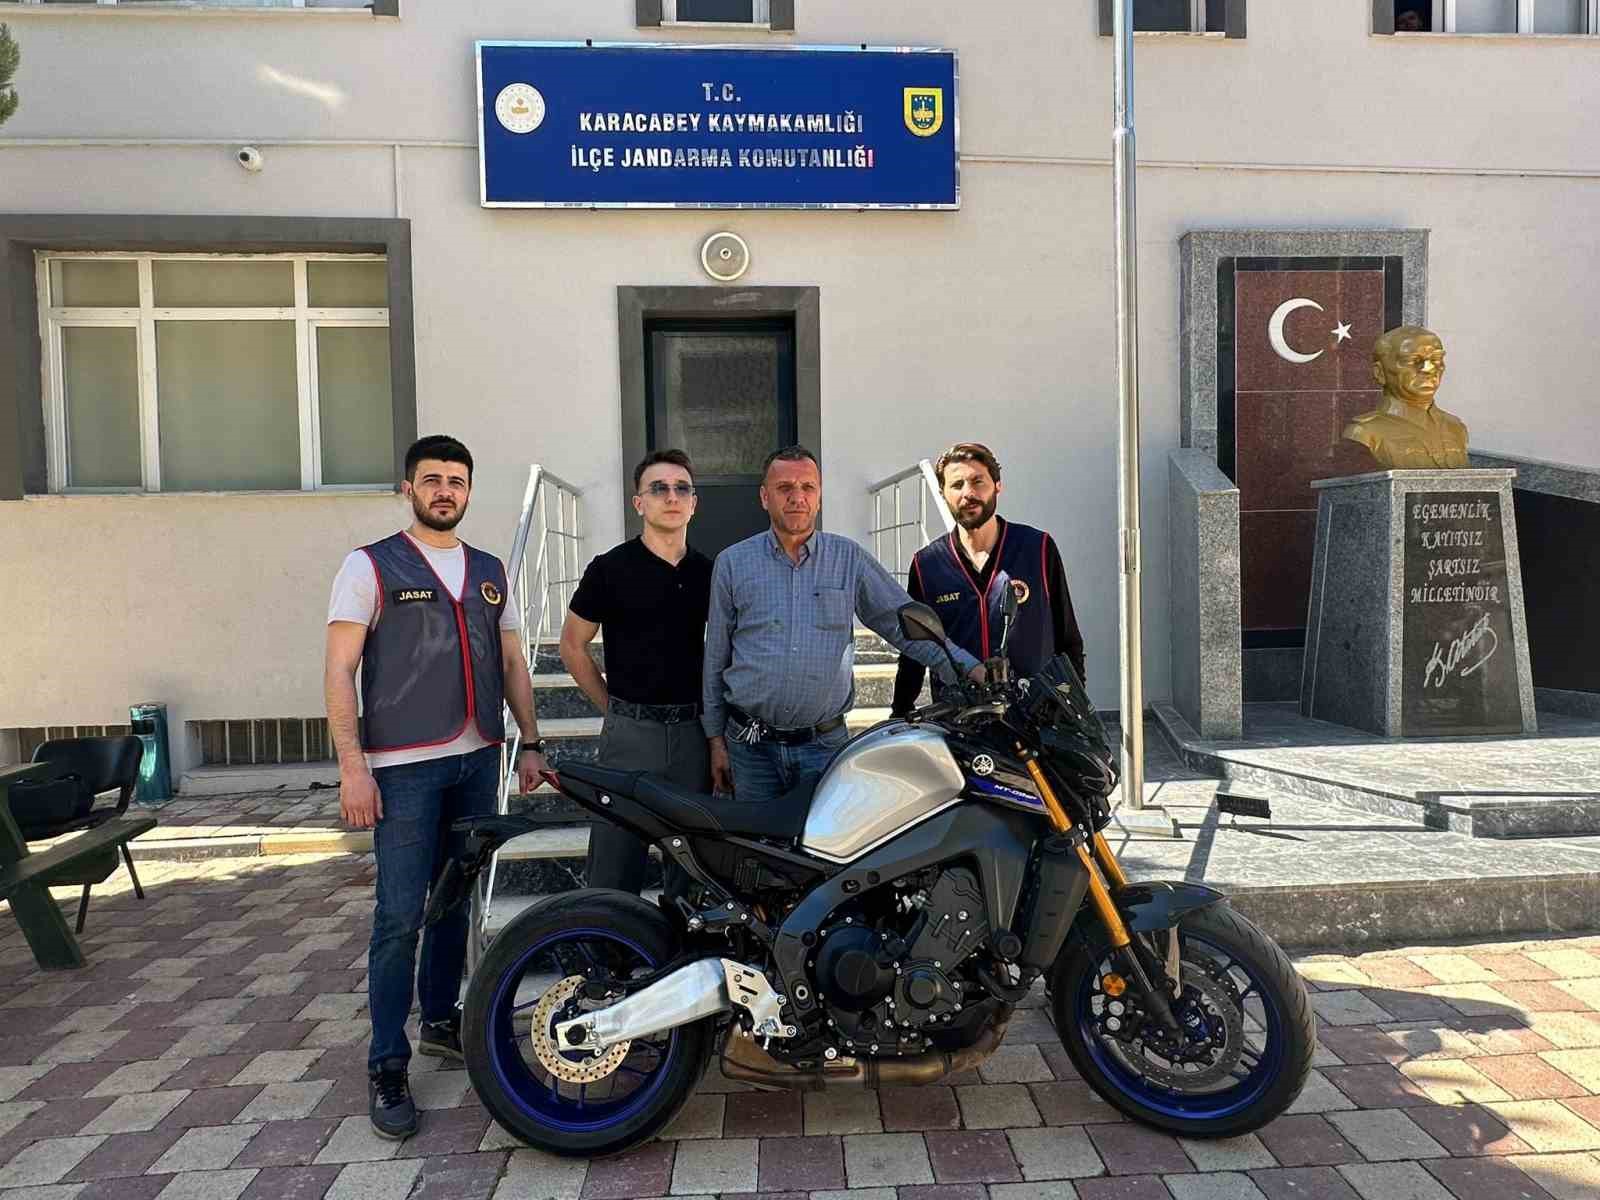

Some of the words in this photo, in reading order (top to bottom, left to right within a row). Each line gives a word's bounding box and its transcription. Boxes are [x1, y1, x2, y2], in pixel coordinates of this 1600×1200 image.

[702, 82, 742, 102] T.C.
[579, 112, 701, 132] KARACABEY
[708, 110, 863, 133] KAYMAKAMLIĞI
[571, 144, 614, 172] İLÇE
[621, 148, 733, 167] JANDARMA
[739, 144, 874, 168] KOMUTANLIĞI
[1412, 499, 1492, 524] EGEMENLİK
[1421, 530, 1484, 549] KAYITSIZ
[1428, 558, 1481, 580] ŞARTSIZ
[400, 590, 433, 601] JASAT
[936, 591, 961, 604] JASAT
